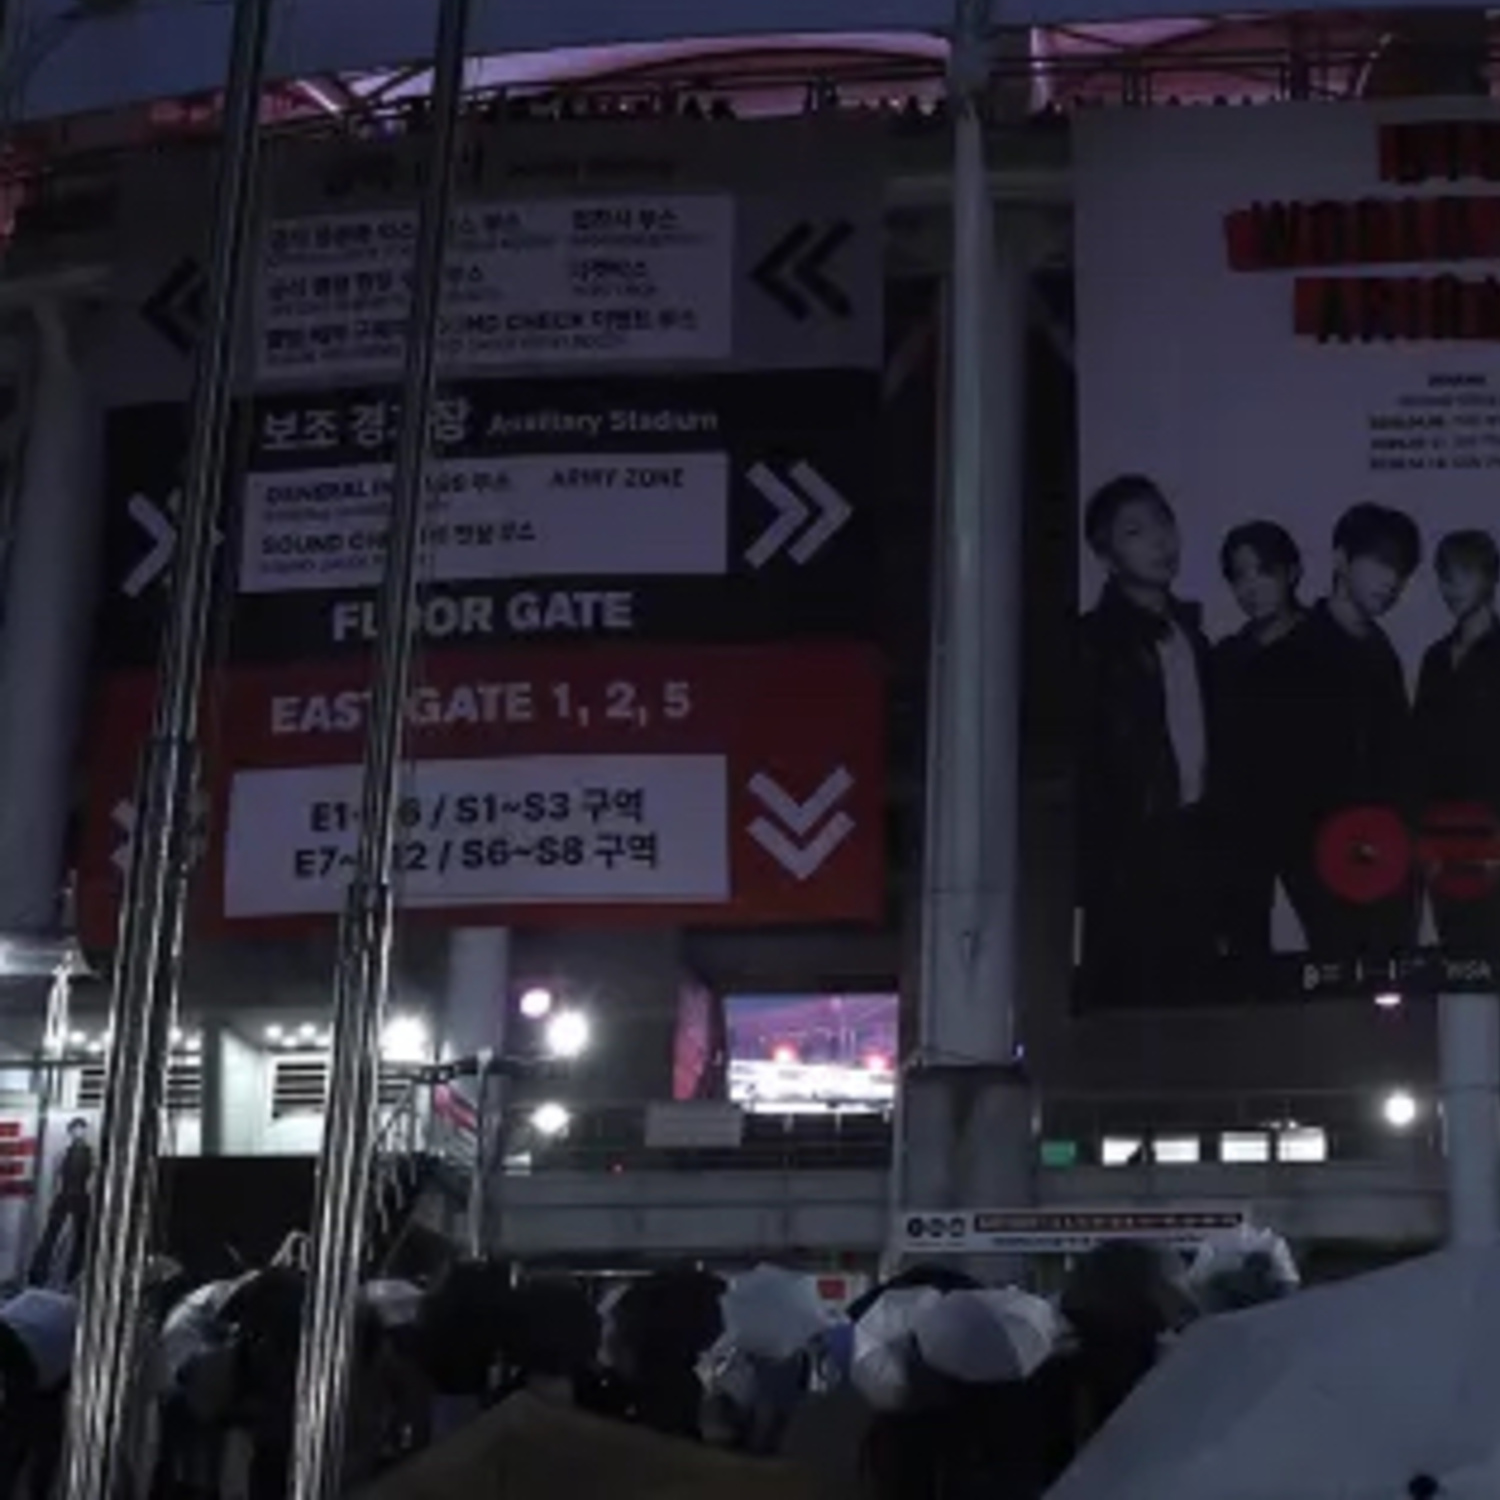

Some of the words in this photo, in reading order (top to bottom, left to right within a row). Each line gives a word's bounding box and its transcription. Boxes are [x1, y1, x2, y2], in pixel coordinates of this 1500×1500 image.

[261, 409, 340, 451] 보조
[349, 396, 471, 449] 경장
[609, 408, 719, 432] Stadium
[550, 467, 616, 489] ARMY
[623, 466, 685, 489] ZONE
[261, 531, 344, 556] SOUND
[332, 595, 494, 642] FLOR
[504, 588, 635, 632] GATE
[270, 691, 373, 736] EAS
[405, 681, 534, 725] GATE
[552, 682, 590, 727] 1,
[604, 679, 647, 728] 2,
[661, 680, 695, 718] 5
[428, 792, 448, 832] /
[454, 790, 571, 824] S1~S3
[582, 786, 647, 824] 구역
[438, 839, 455, 875] /
[459, 835, 585, 871] S6~S8
[593, 832, 660, 870] 구역
